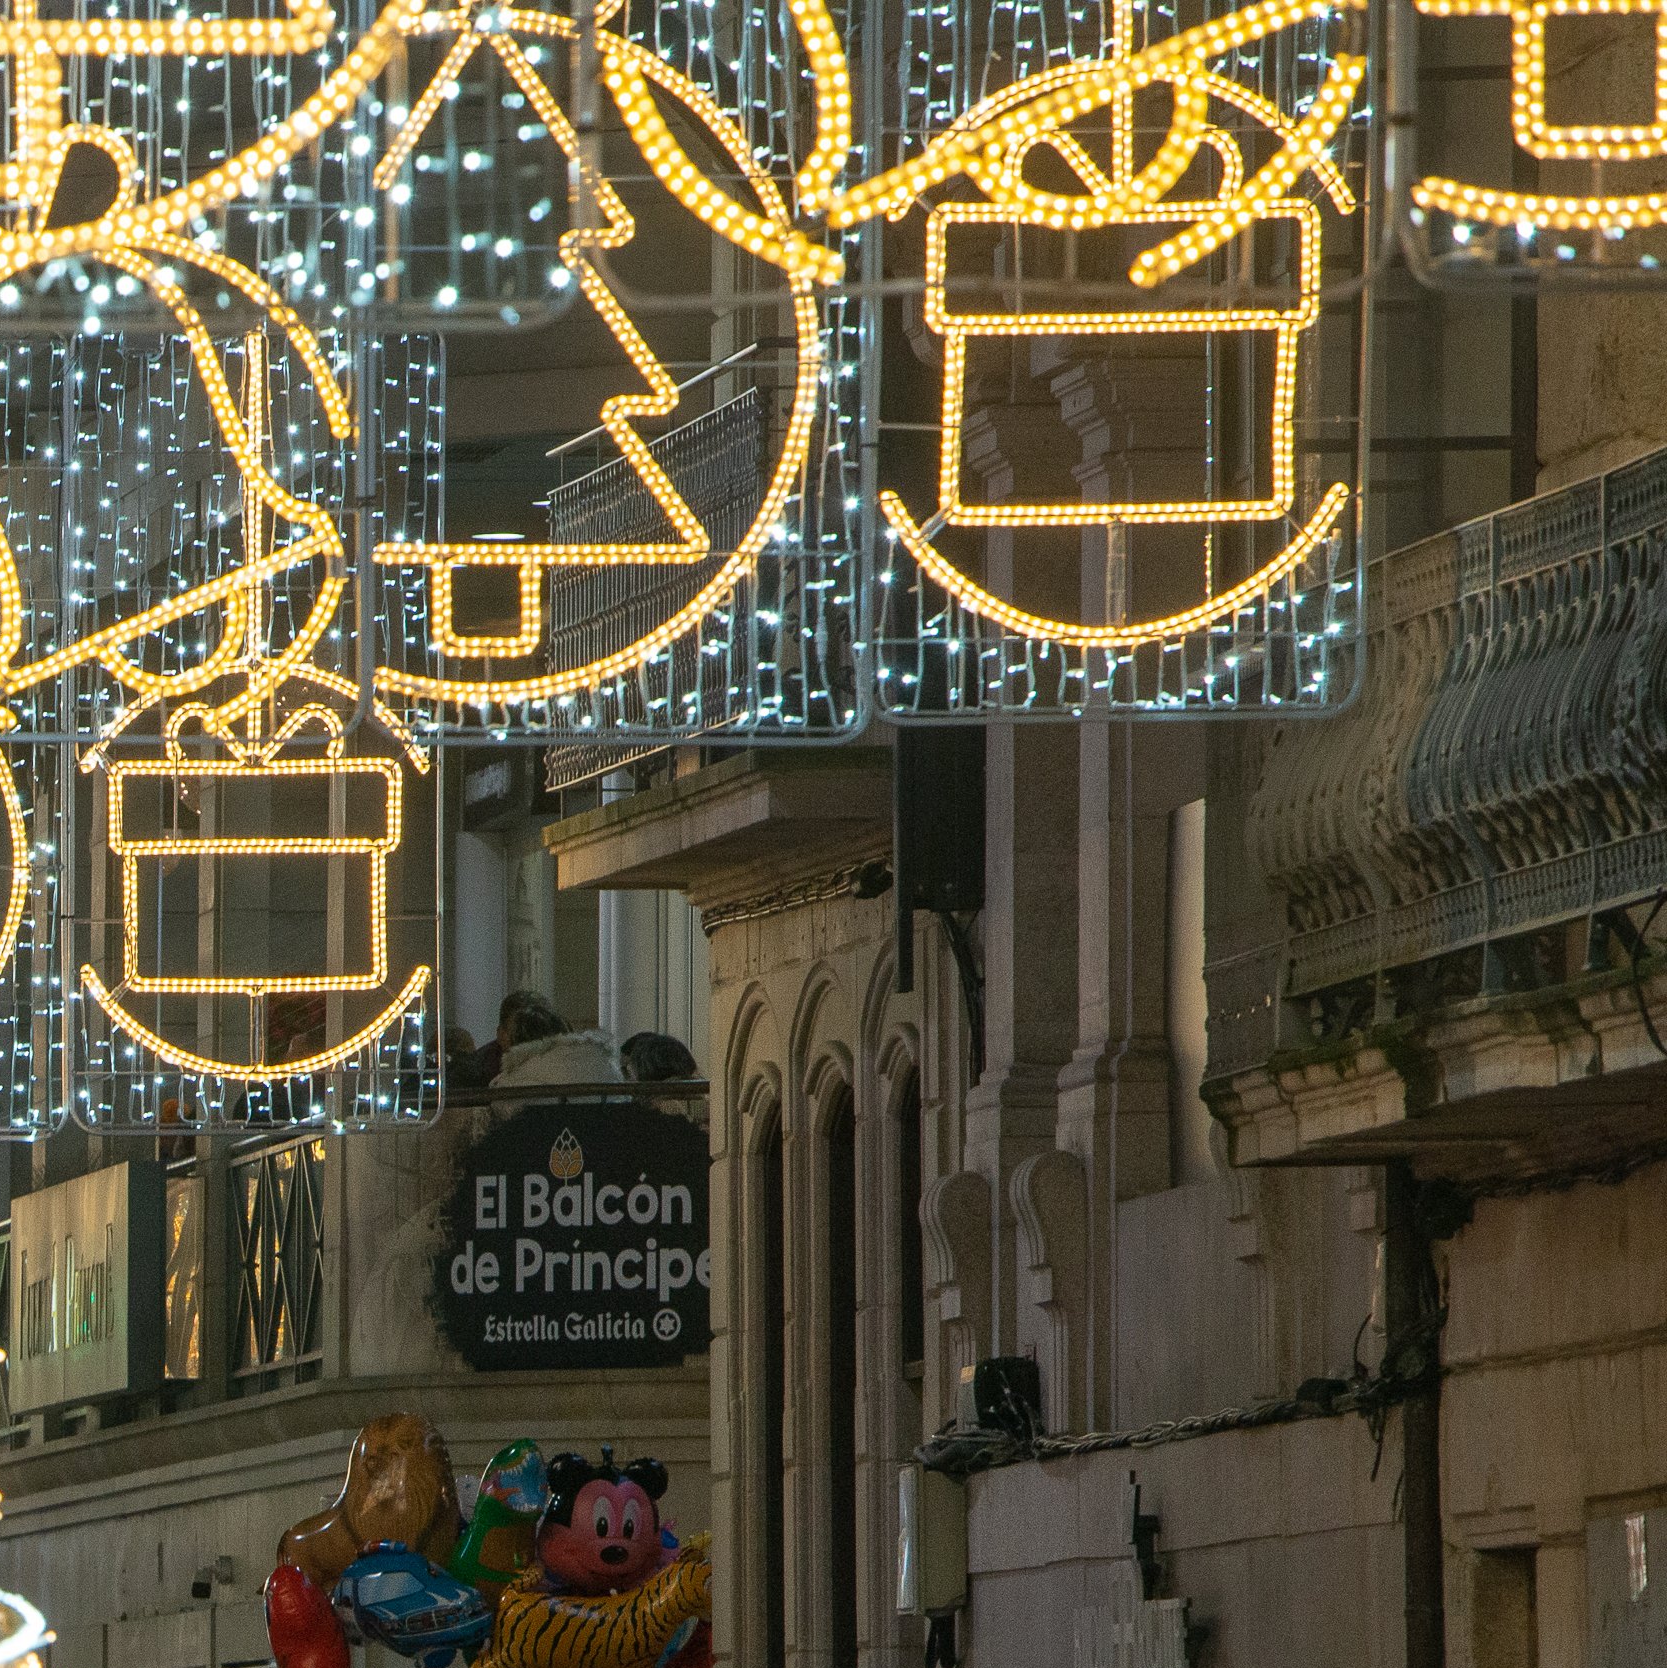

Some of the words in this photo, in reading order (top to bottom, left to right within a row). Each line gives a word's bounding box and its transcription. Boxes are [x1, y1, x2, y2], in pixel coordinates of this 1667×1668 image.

[475, 1173, 507, 1229] El
[523, 1172, 693, 1228] Balcón
[450, 1240, 500, 1294] de
[483, 1314, 560, 1343] Estrella
[564, 1311, 646, 1341] Galicia
